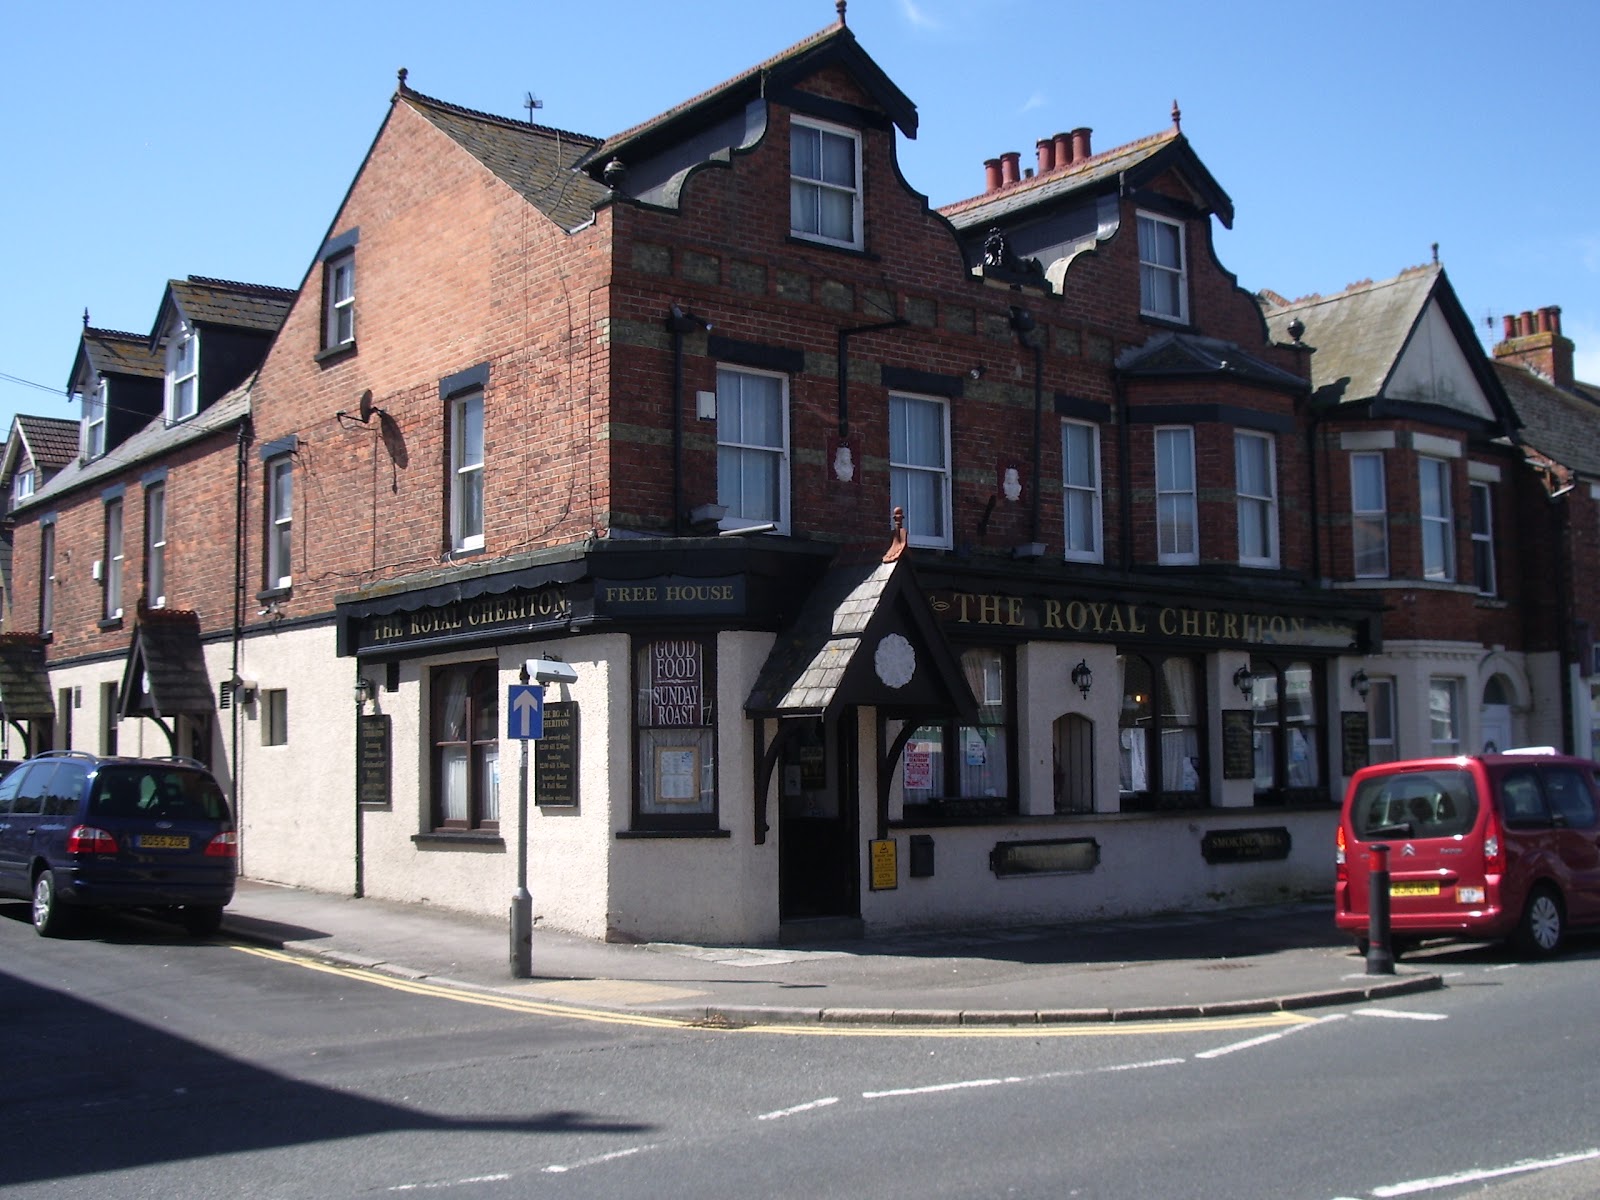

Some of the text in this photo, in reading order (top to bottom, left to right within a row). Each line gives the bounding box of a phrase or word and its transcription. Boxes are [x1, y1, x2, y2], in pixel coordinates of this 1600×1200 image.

[606, 585, 734, 602] FREE HOUSE
[374, 588, 568, 641] THE ROYAL CHERITON
[953, 592, 1305, 643] THE ROYAL CHERITON
[655, 641, 696, 658] GOOD
[656, 658, 696, 678] FOOD
[653, 686, 698, 705] SUNDAY
[658, 705, 695, 725] ROAST
